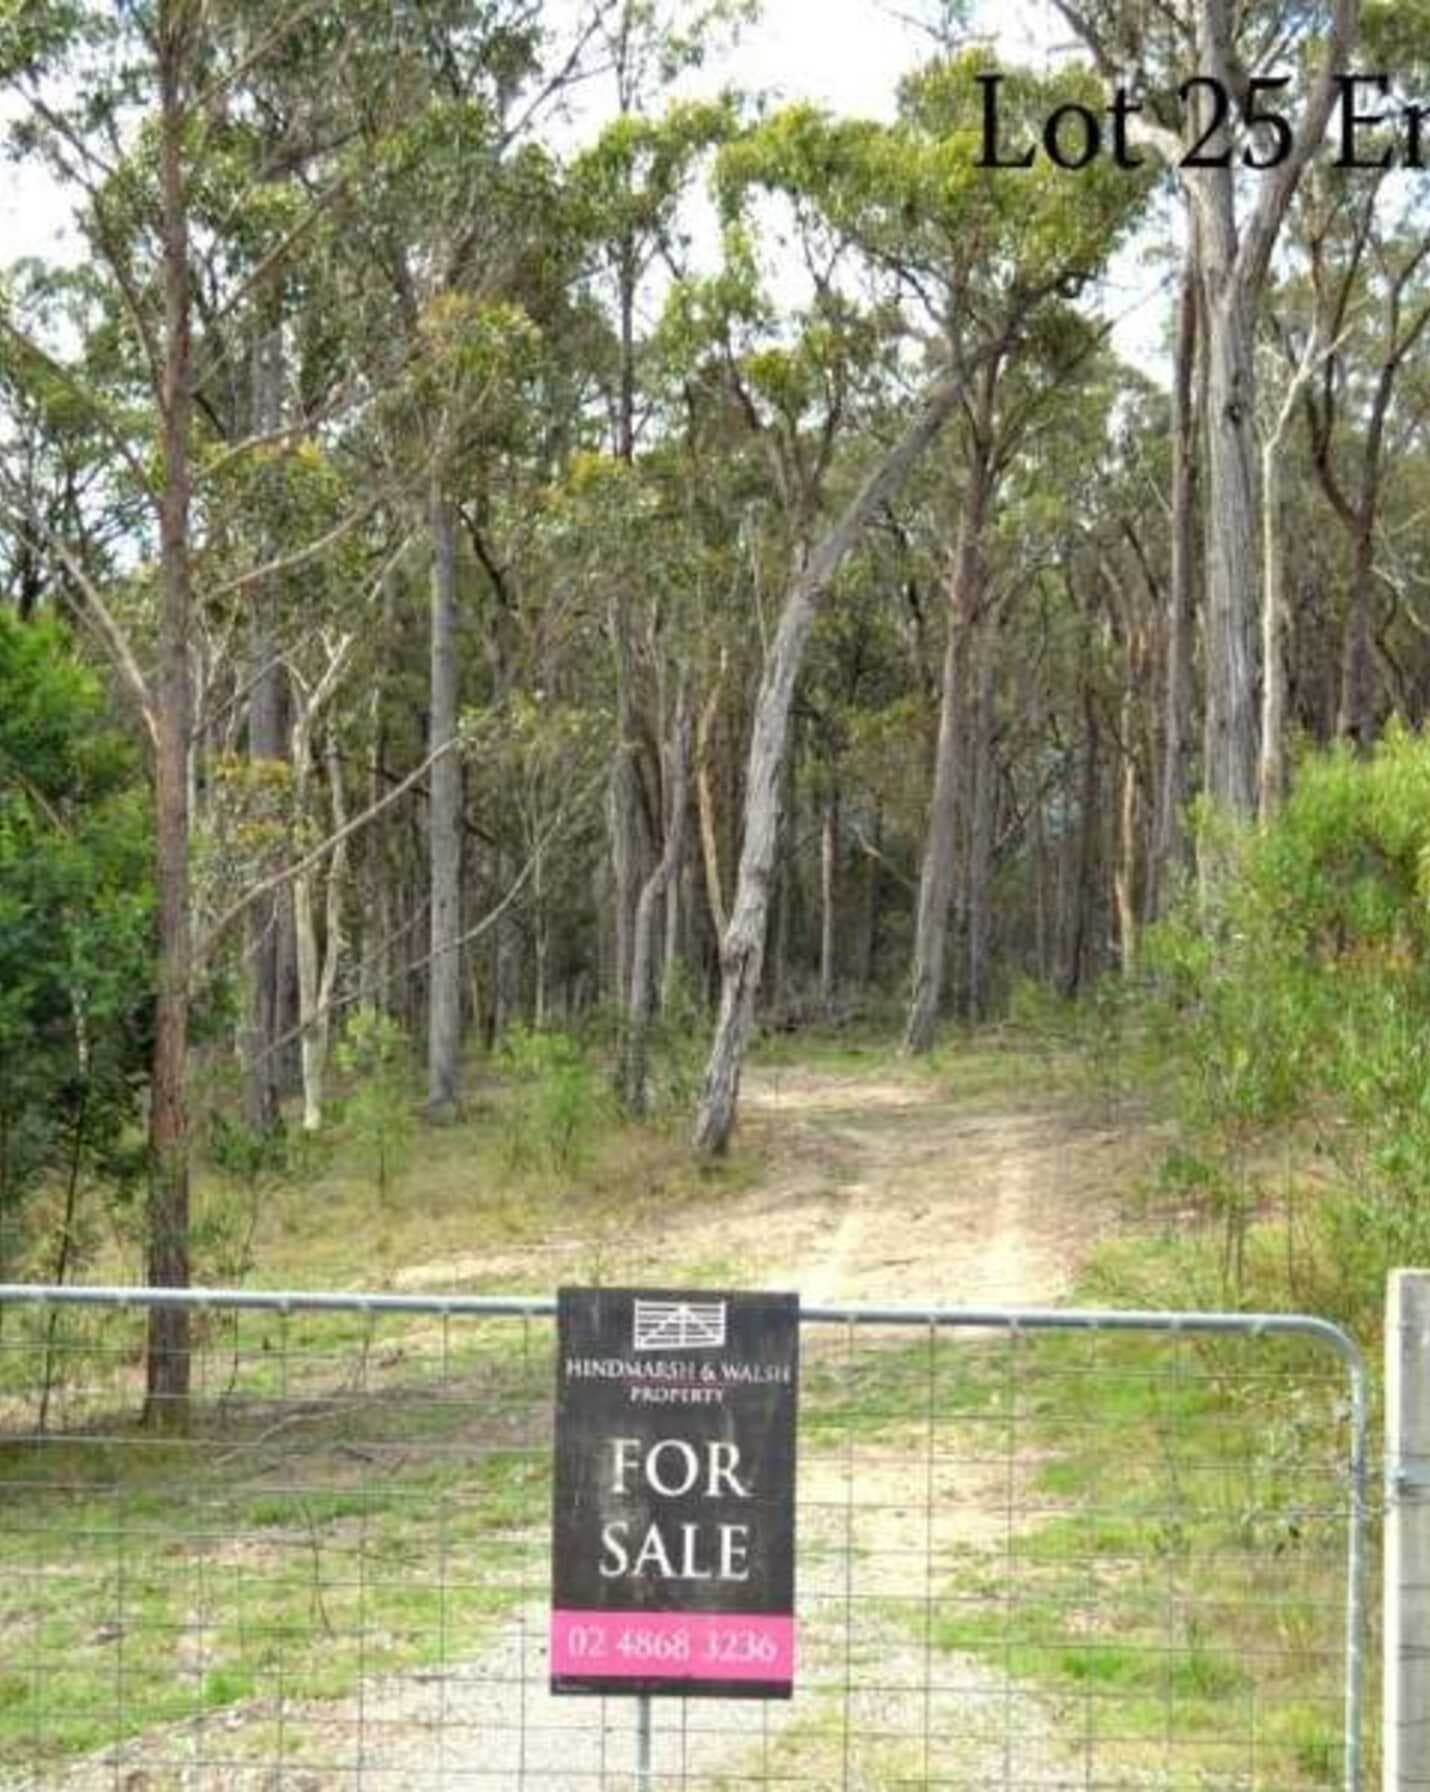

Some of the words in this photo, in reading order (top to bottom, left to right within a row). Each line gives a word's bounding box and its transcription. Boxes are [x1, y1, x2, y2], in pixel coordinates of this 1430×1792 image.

[566, 1357, 696, 1381] HINDMARSH
[700, 1362, 717, 1382] &
[720, 1362, 792, 1383] WALSH
[630, 1385, 725, 1404] PROPERTY
[611, 1438, 751, 1497] FOR
[599, 1520, 750, 1581] SALE
[567, 1625, 609, 1658] 02
[616, 1627, 691, 1661] 4868
